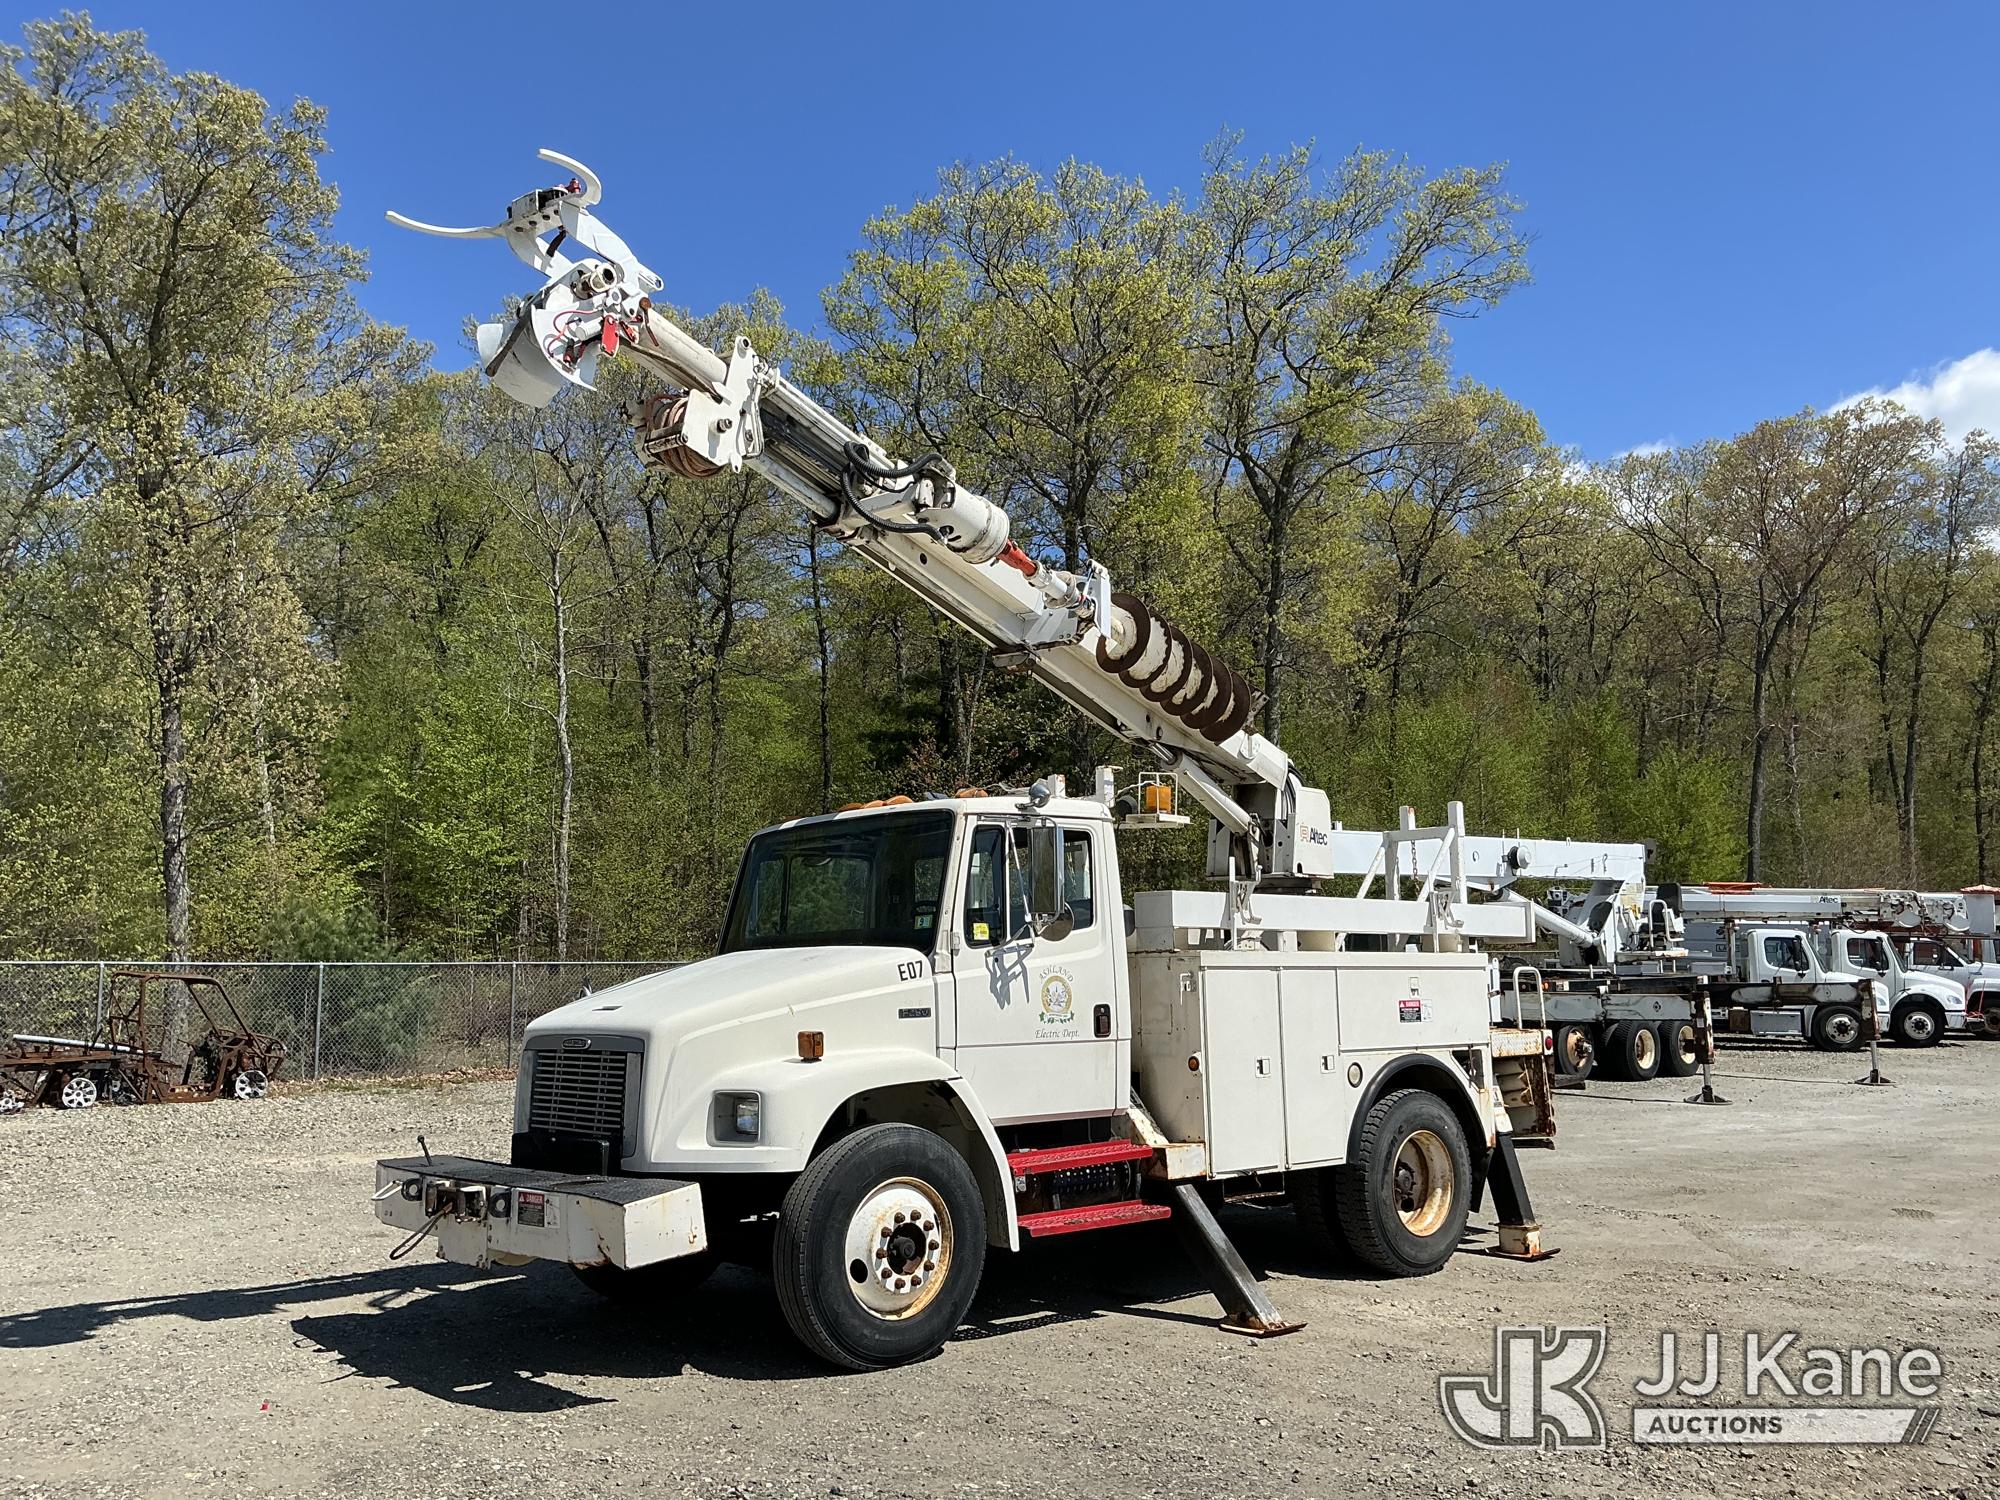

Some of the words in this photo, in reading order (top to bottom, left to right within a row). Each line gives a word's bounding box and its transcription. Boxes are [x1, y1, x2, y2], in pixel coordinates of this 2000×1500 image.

[1310, 827, 1328, 846] Altec
[897, 960, 923, 982] E07
[1039, 965, 1074, 982] ASHLAND
[1035, 1028, 1060, 1039] Electric
[1062, 1028, 1080, 1040] Dept.
